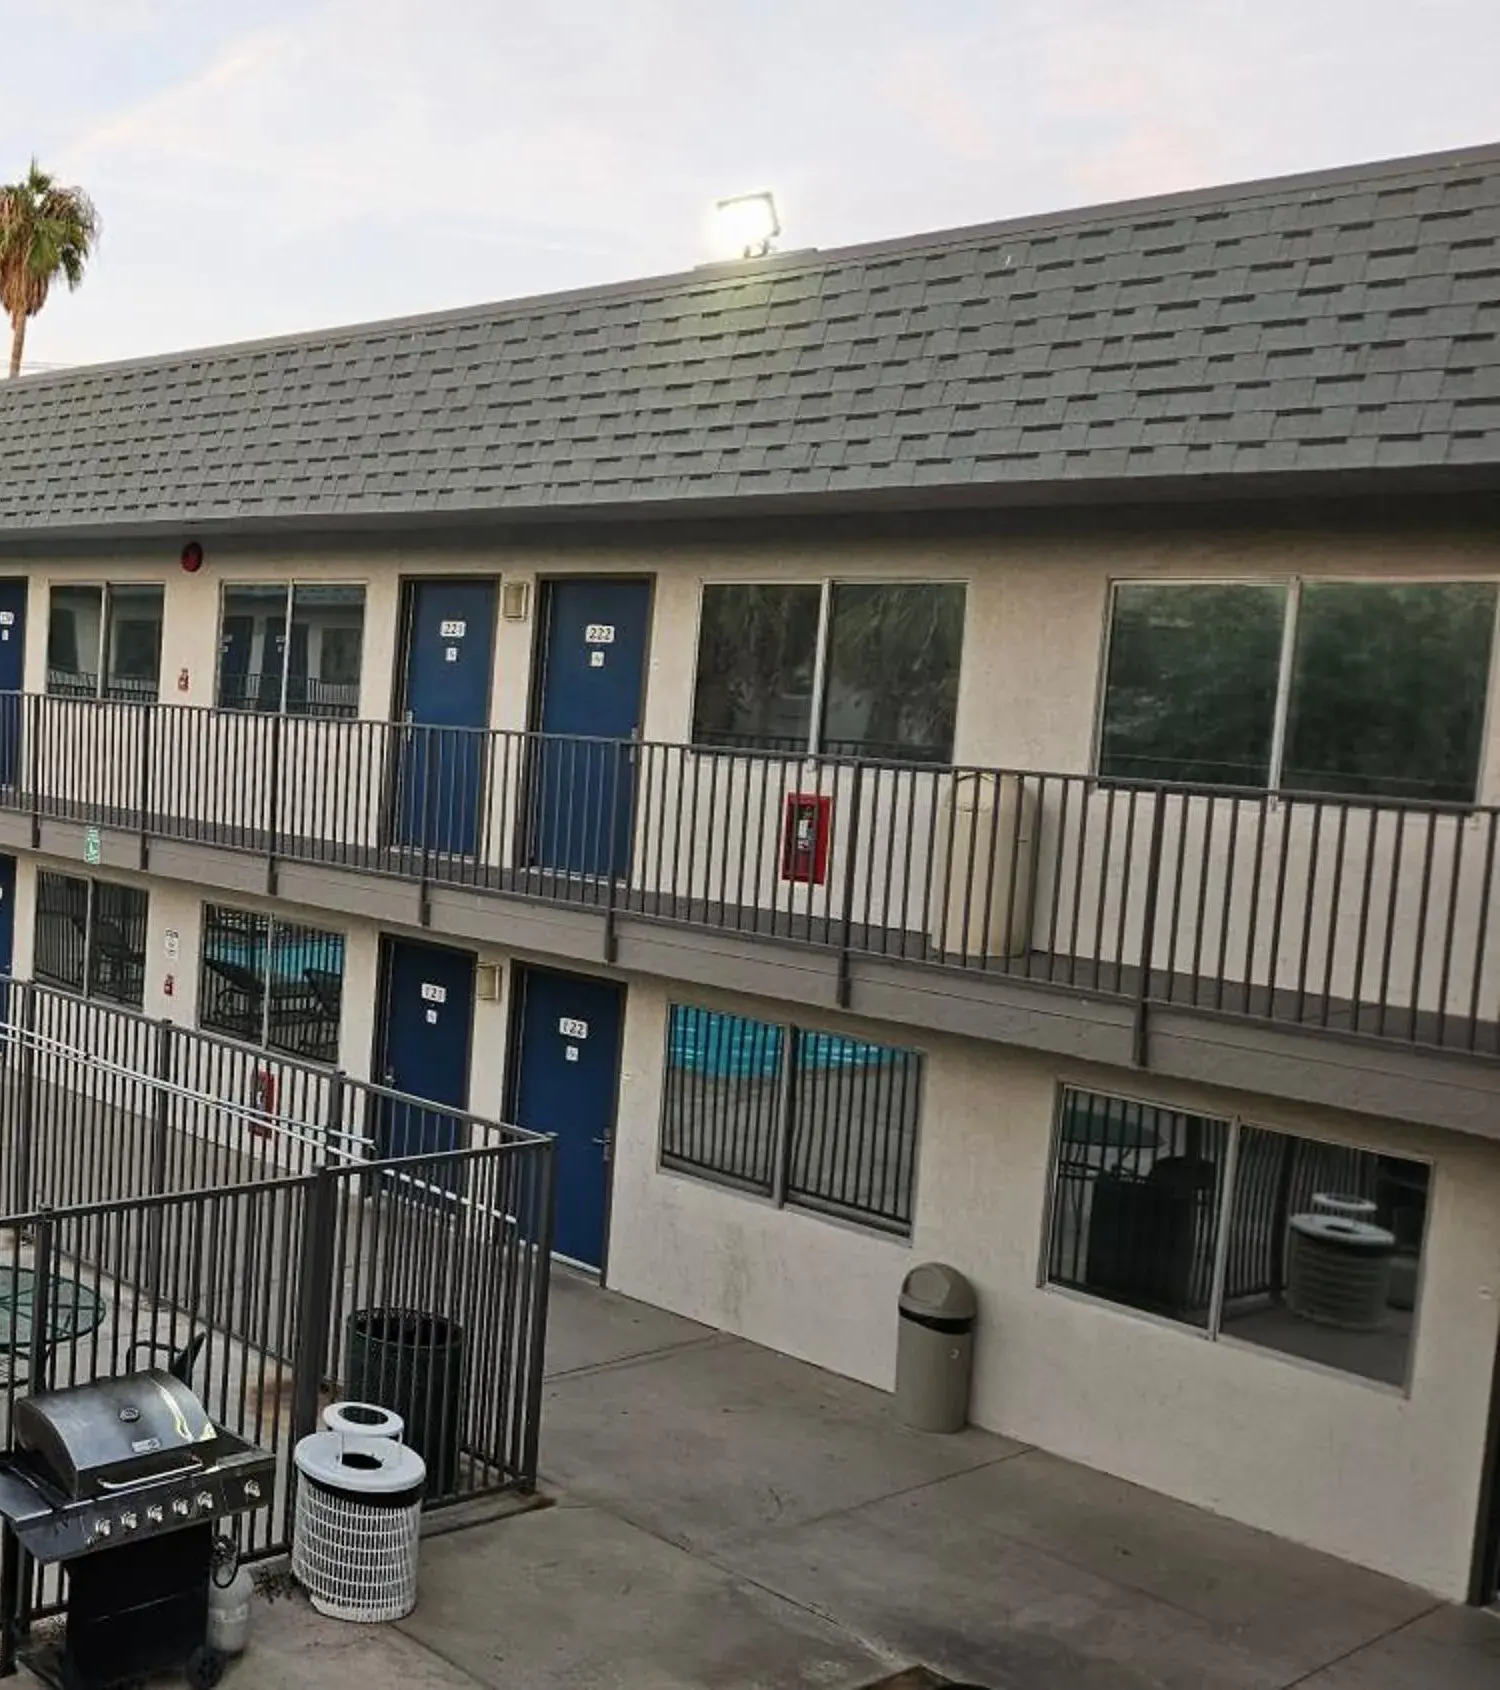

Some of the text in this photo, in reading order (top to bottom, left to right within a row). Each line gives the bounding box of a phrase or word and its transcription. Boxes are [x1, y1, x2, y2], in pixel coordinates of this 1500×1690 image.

[444, 622, 464, 636] 221
[588, 626, 612, 641] 222
[424, 984, 444, 1001] 121
[562, 1018, 584, 1036] 122
